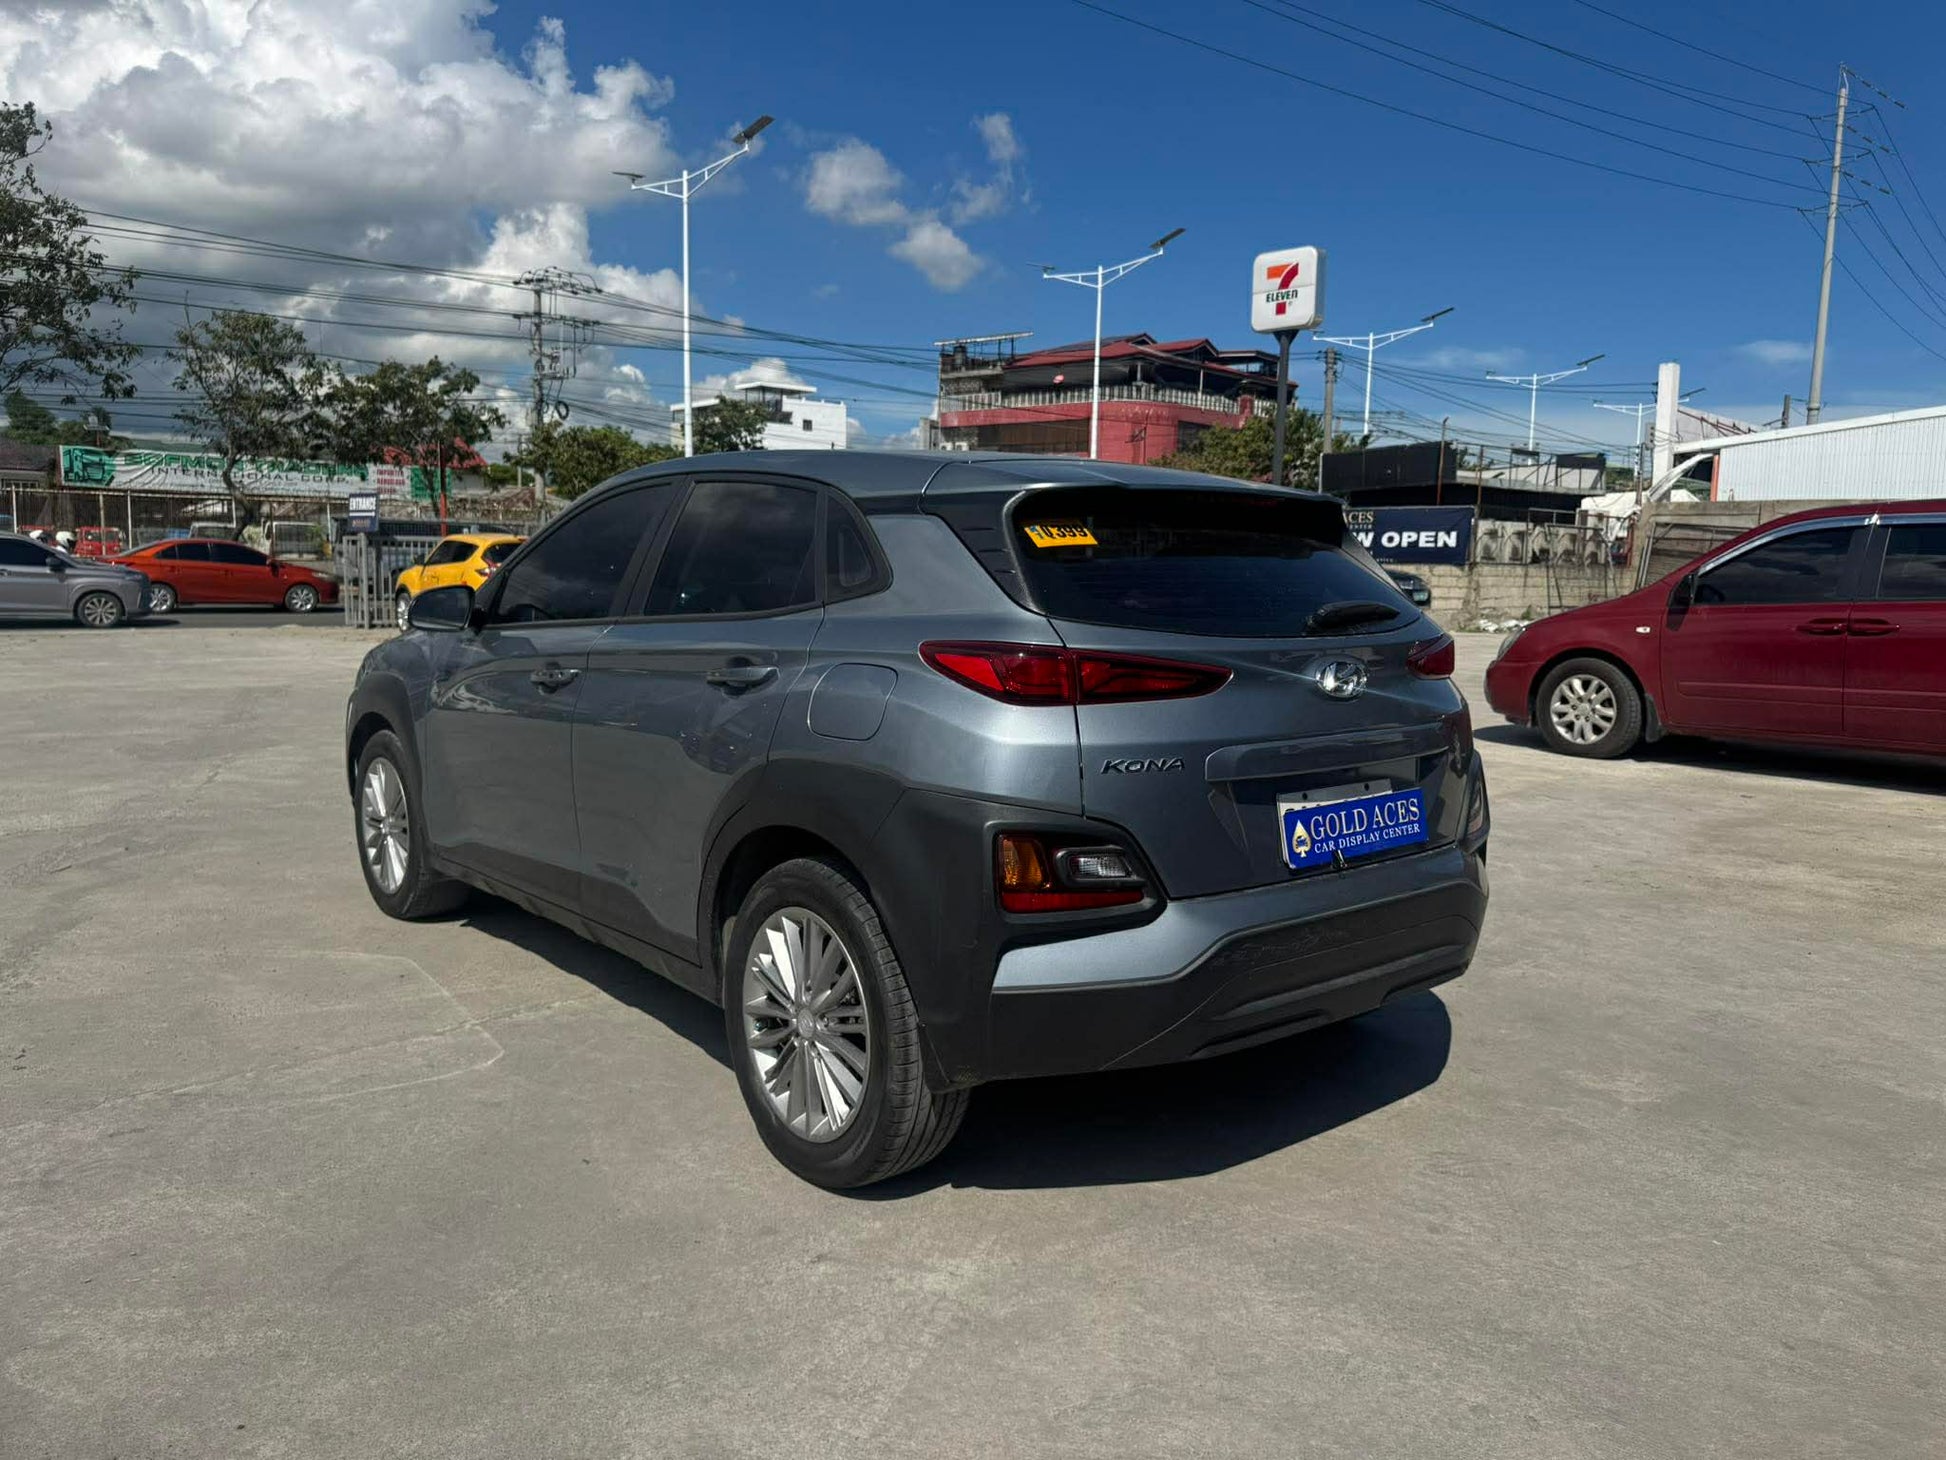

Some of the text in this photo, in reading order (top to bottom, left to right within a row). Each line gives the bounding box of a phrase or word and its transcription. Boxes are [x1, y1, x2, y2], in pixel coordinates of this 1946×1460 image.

[1266, 262, 1299, 316] 7
[151, 467, 293, 482] INTERNTIONAL
[1381, 531, 1458, 548] OPEN
[1100, 757, 1186, 775] KONA
[1310, 798, 1420, 840] GOLD ACES
[1314, 823, 1421, 853] CAR DISPLAY CENTER
